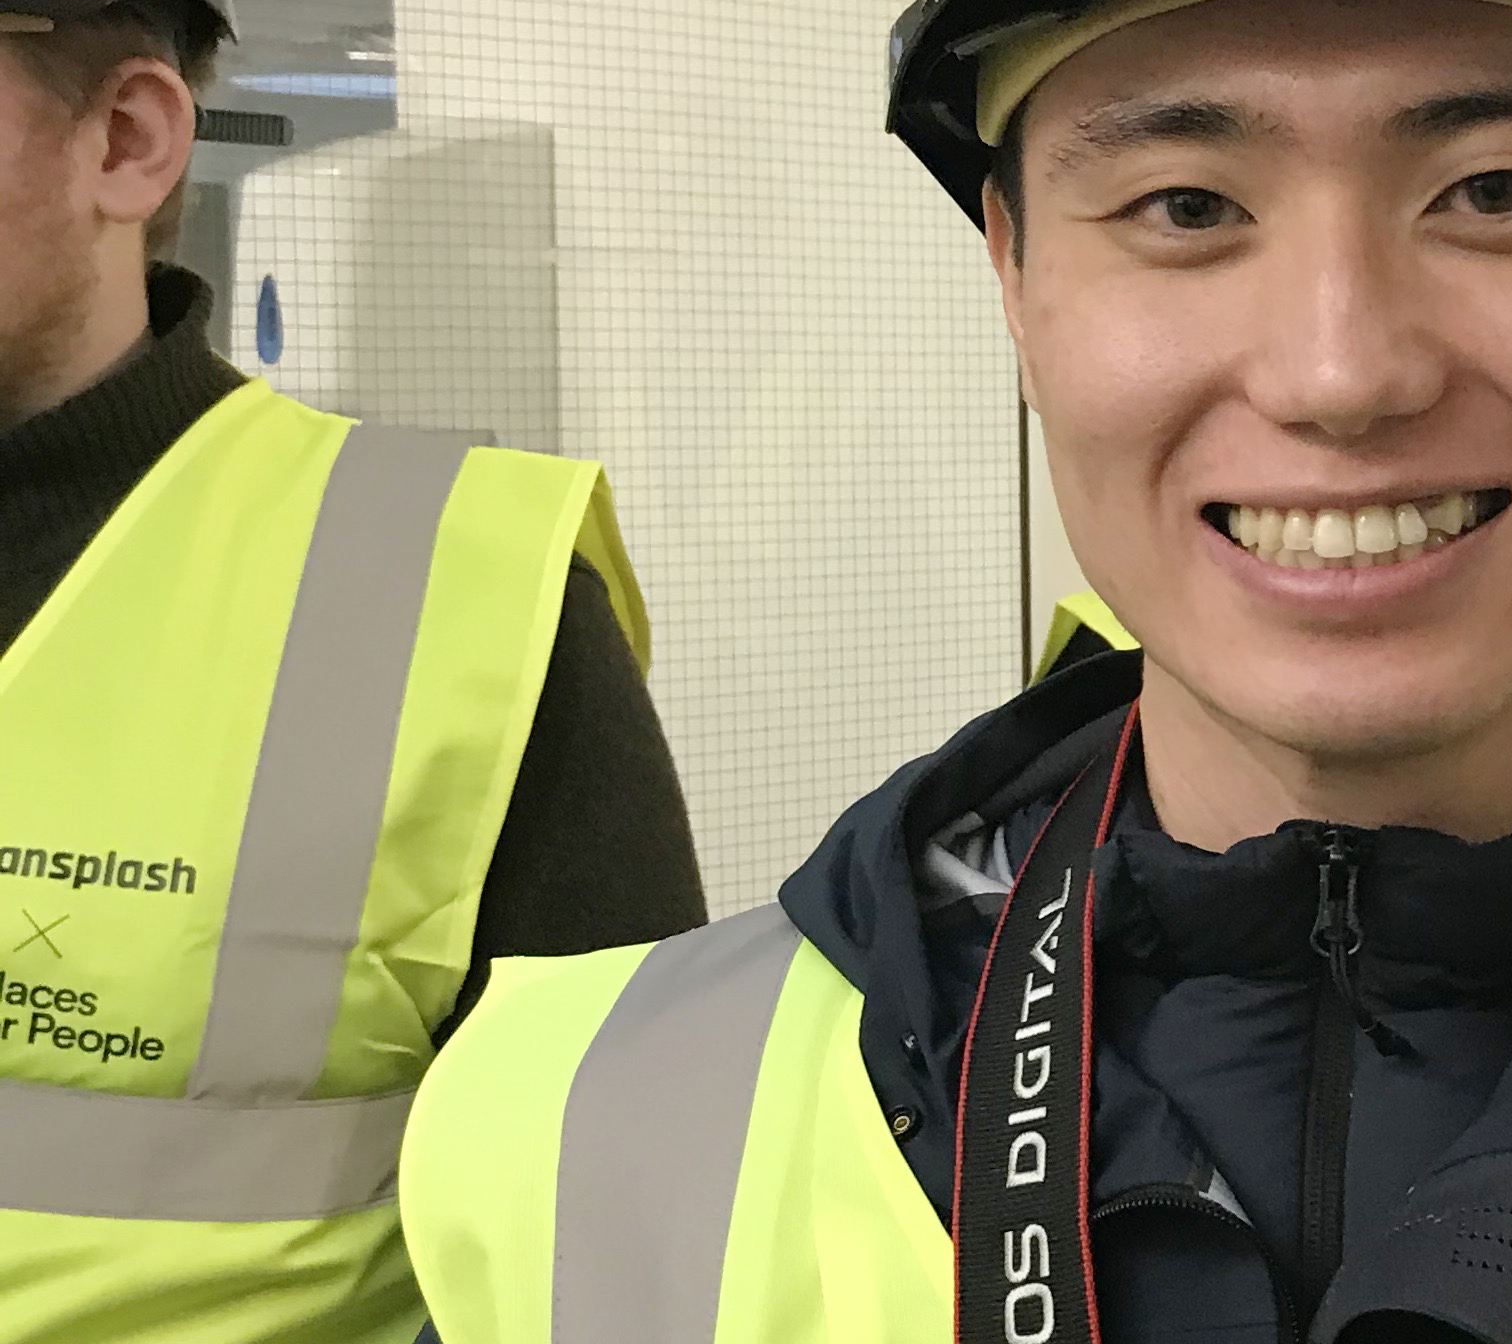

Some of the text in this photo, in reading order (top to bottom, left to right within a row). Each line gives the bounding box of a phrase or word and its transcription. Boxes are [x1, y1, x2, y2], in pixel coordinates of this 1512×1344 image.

[0, 846, 197, 894] ansplash
[28, 1012, 165, 1064] People
[1005, 866, 1072, 1188] DIGITAL
